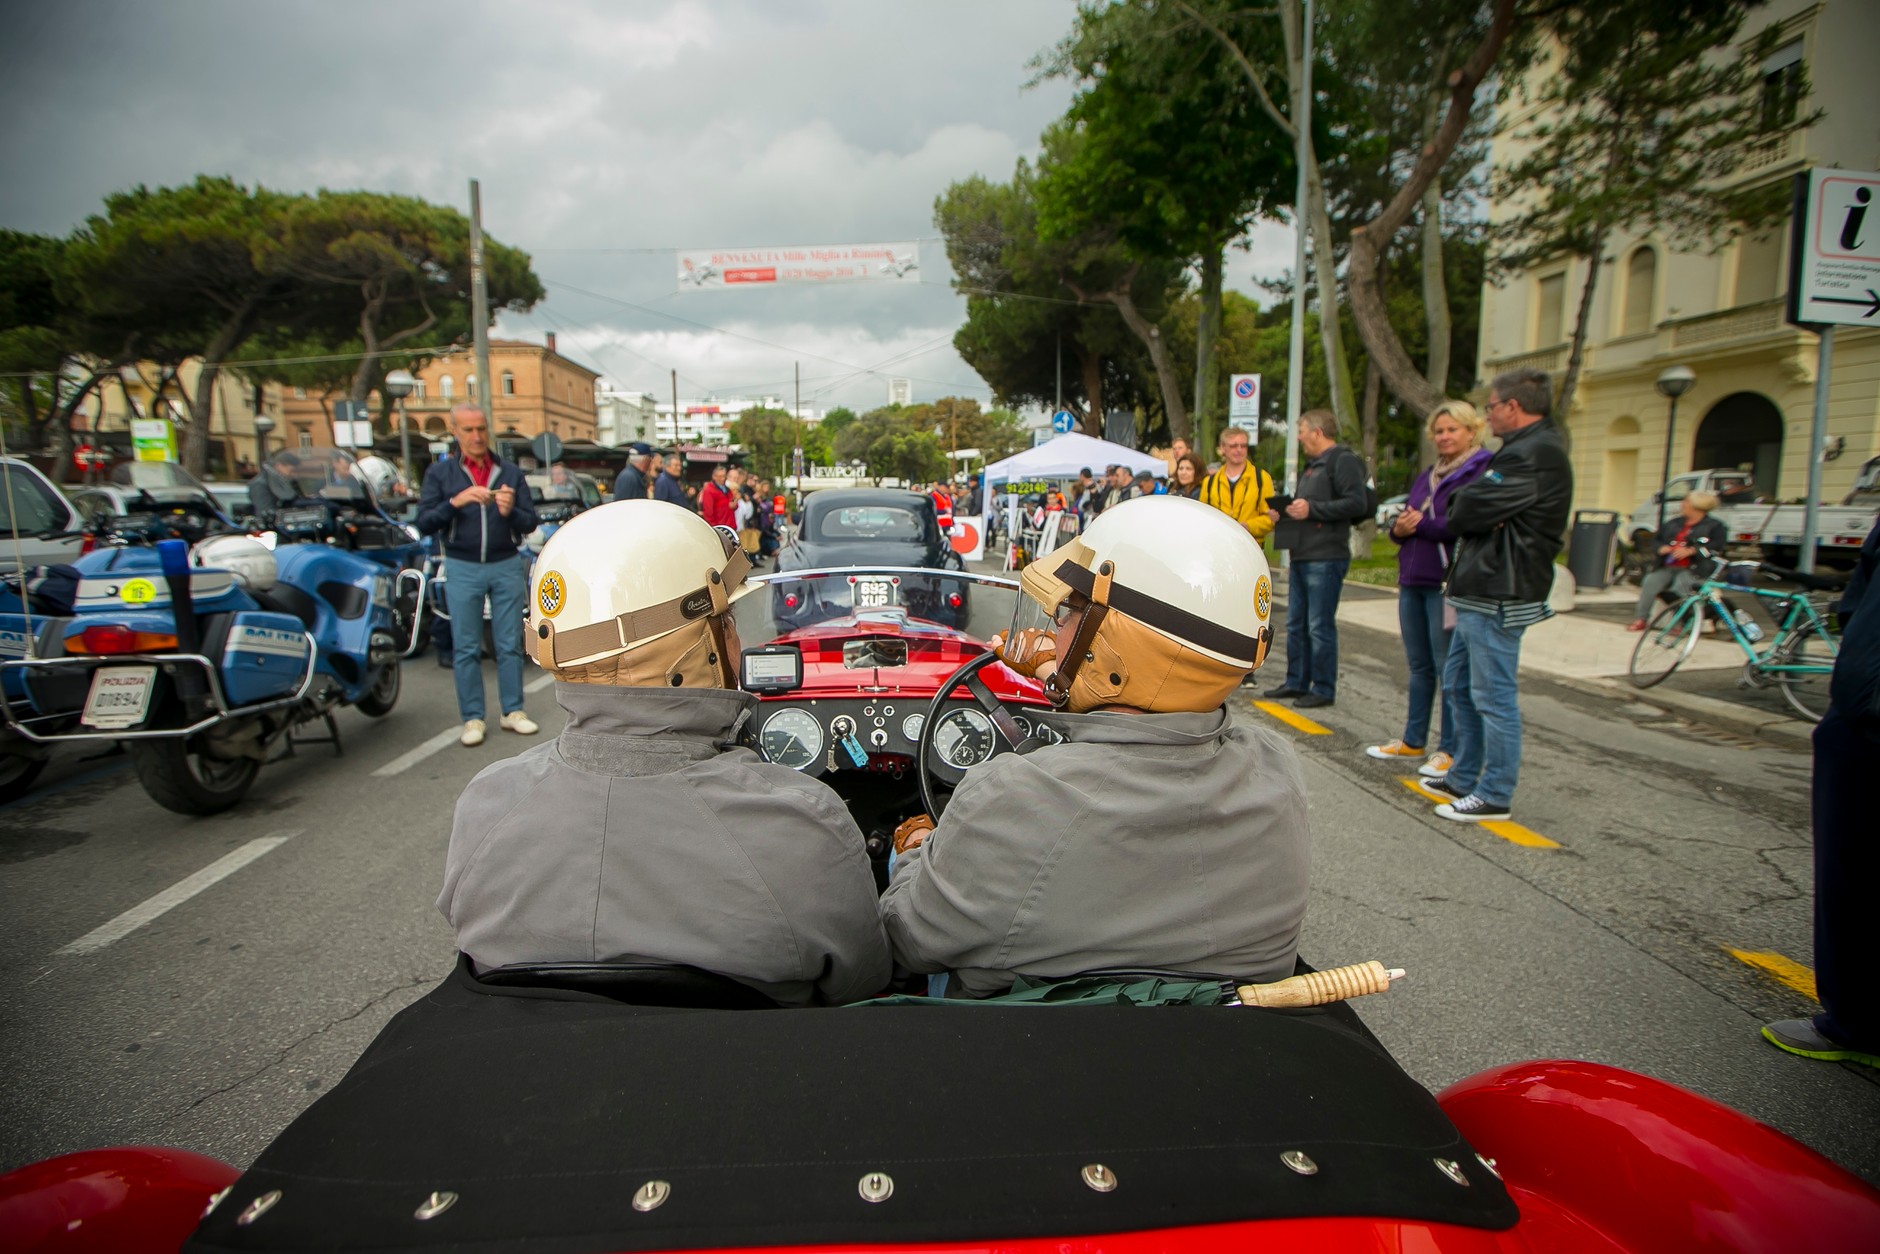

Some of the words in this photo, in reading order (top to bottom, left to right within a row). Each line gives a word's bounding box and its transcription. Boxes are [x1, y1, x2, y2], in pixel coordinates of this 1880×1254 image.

[783, 250, 806, 261] Mille
[810, 249, 840, 262] Miglia
[860, 582, 888, 595] 692
[860, 594, 888, 607] XUP
